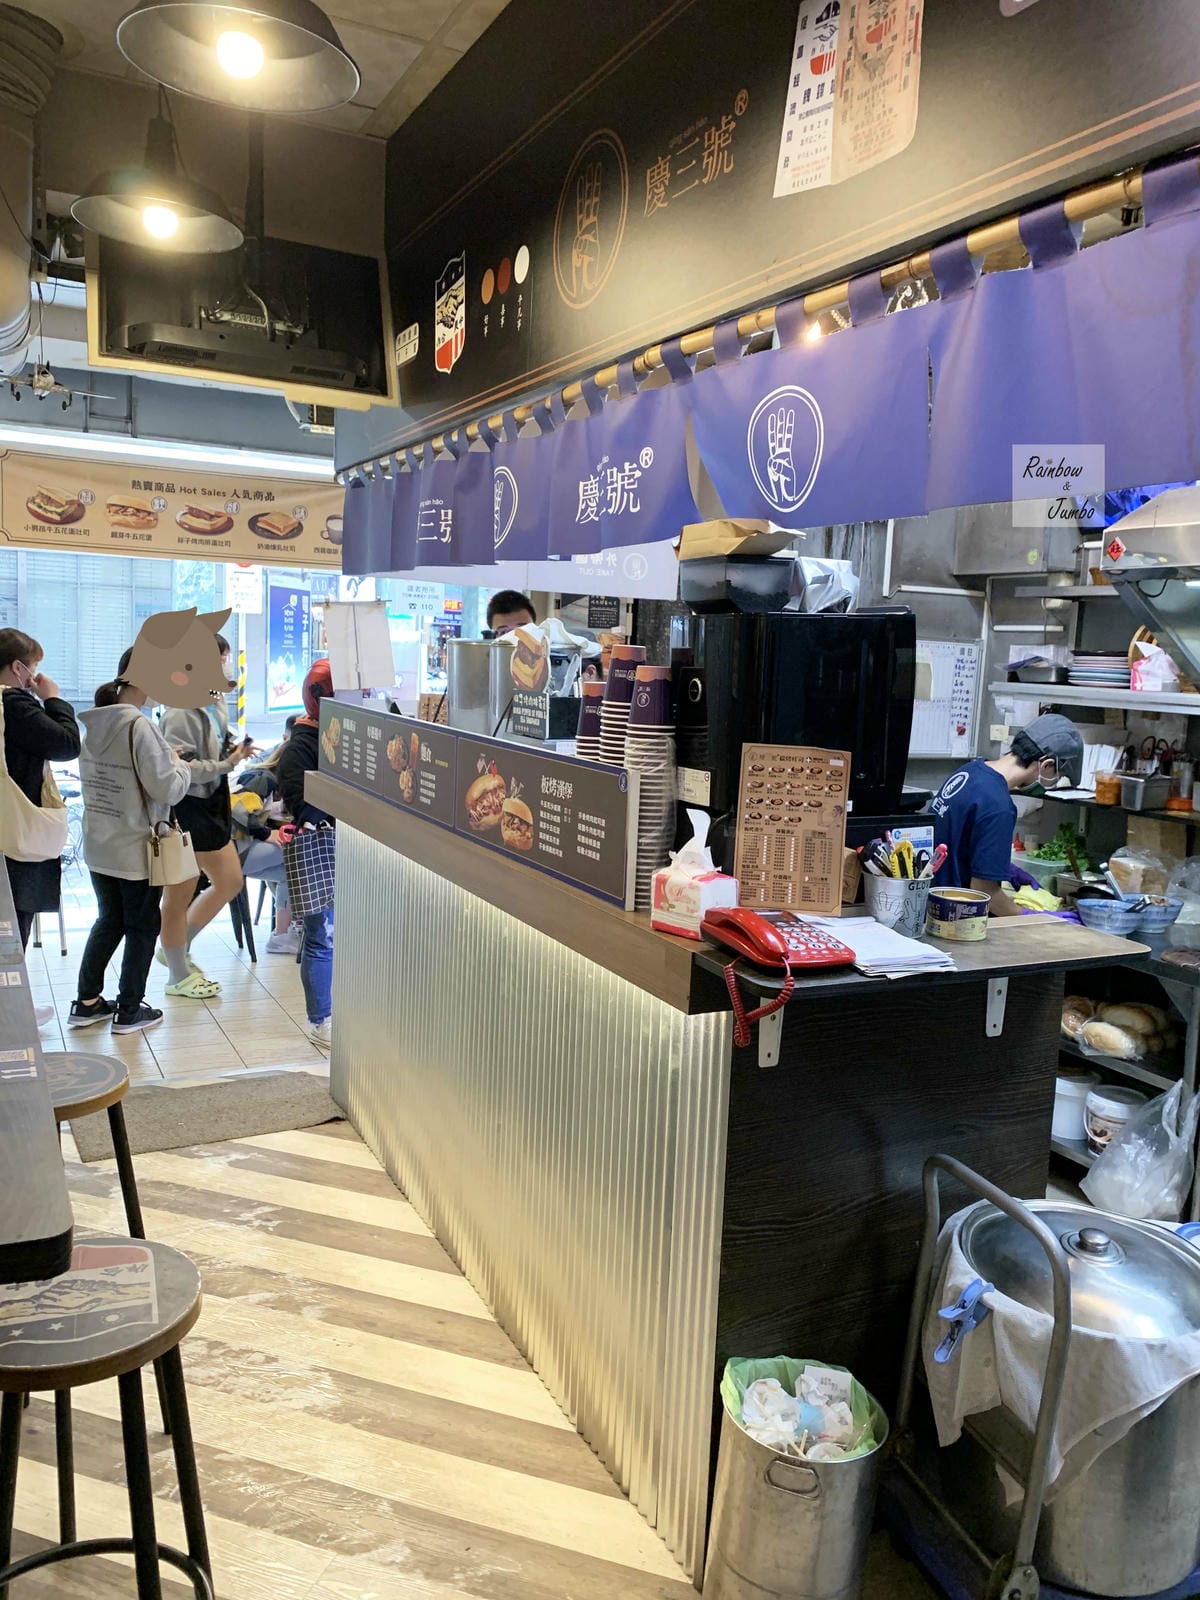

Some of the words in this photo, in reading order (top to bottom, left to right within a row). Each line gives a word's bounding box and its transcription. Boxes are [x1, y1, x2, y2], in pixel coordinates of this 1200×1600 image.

[644, 115, 736, 217] 慶三號
[179, 485, 197, 495] Hot
[201, 487, 227, 497] Sales
